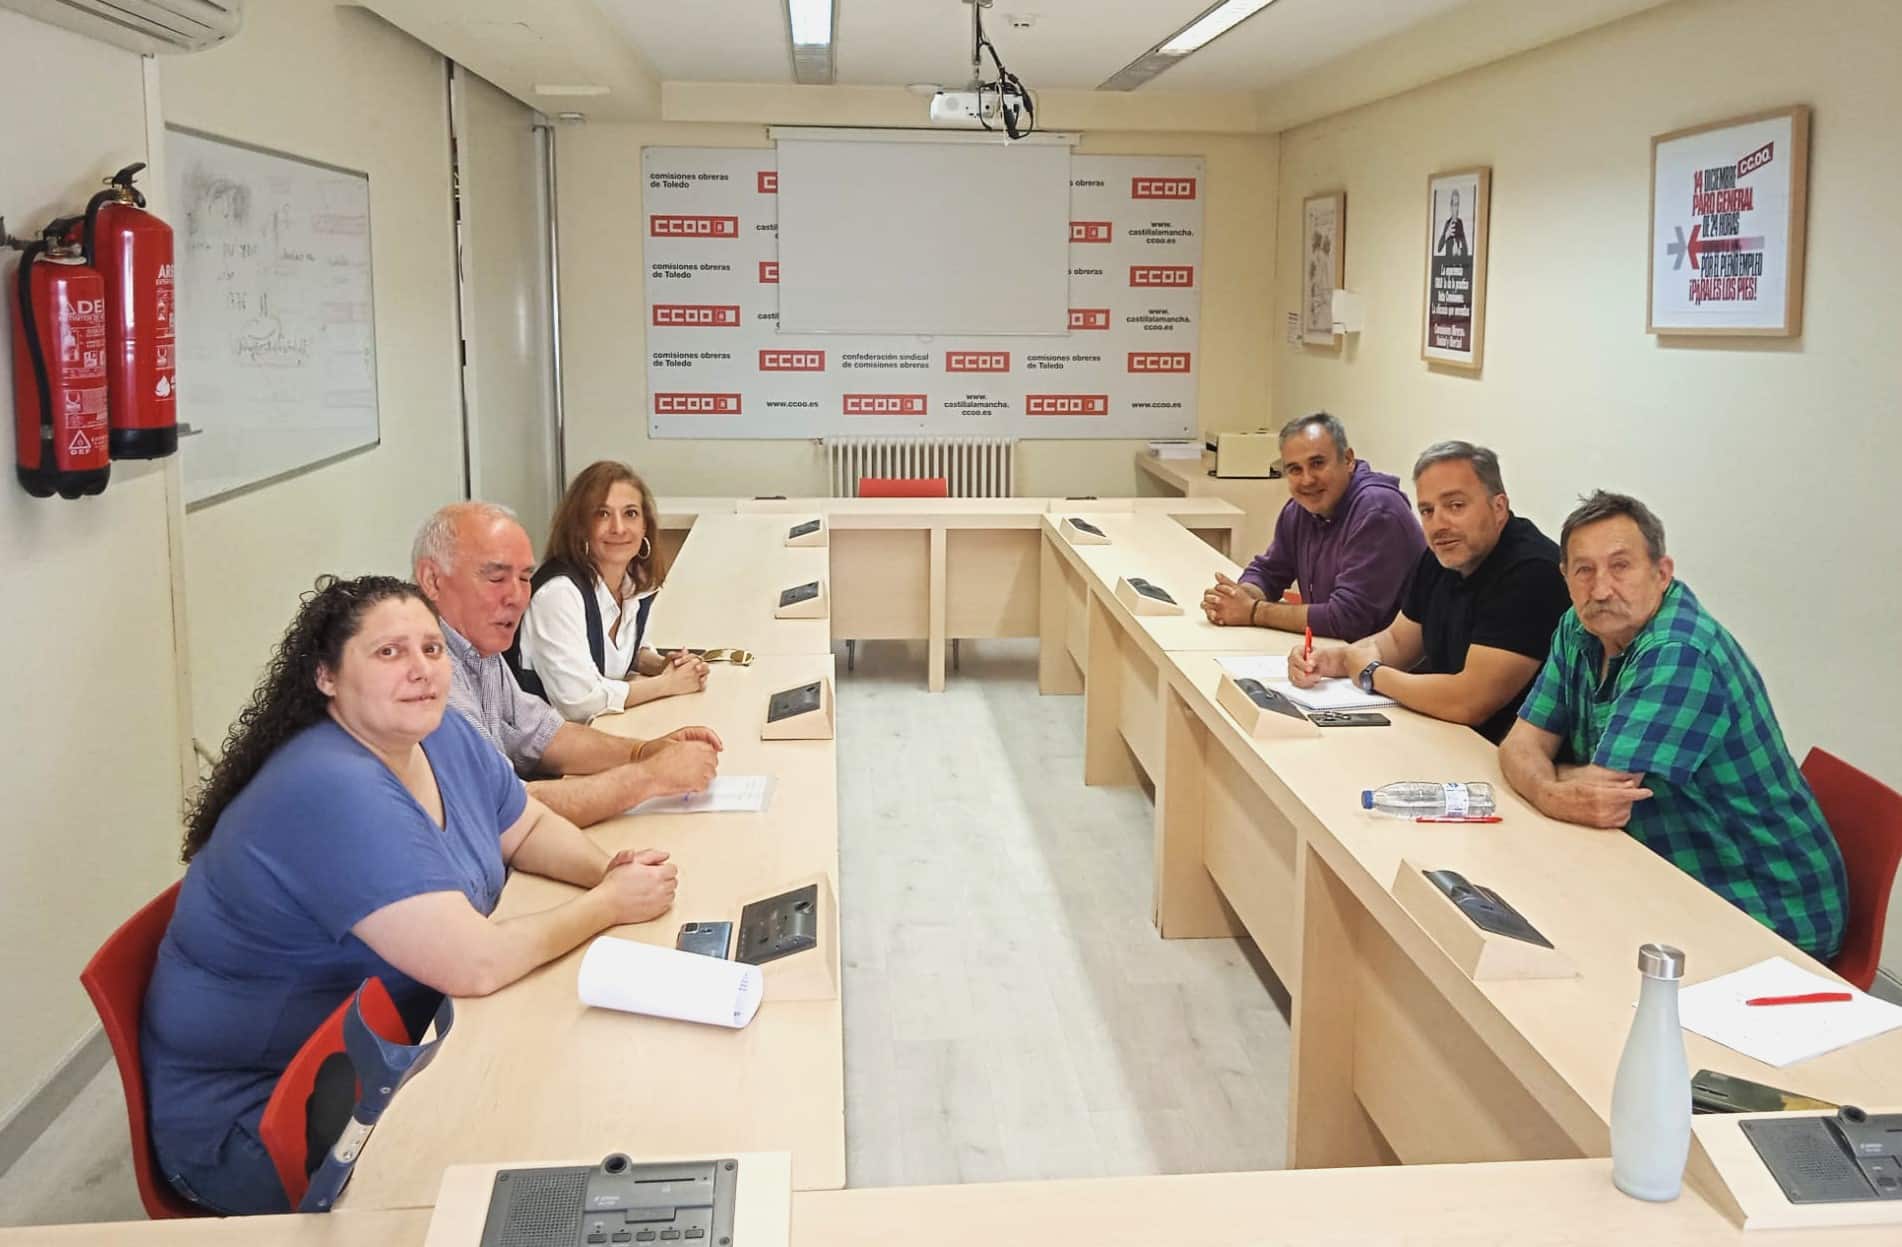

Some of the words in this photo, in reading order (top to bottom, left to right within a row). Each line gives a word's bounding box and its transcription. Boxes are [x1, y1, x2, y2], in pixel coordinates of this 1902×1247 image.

[663, 180, 690, 189] Toledo
[1075, 179, 1104, 187] obreras
[1692, 192, 1716, 216] PARO
[1716, 187, 1753, 213] GENERAL
[700, 263, 731, 271] obreras
[665, 271, 692, 279] Toledo
[1722, 278, 1736, 301] LOS
[842, 352, 898, 360] confederación
[899, 352, 929, 360] sindical
[652, 359, 663, 367] de
[665, 359, 692, 367] Toledo
[1039, 361, 1064, 369] Toledo
